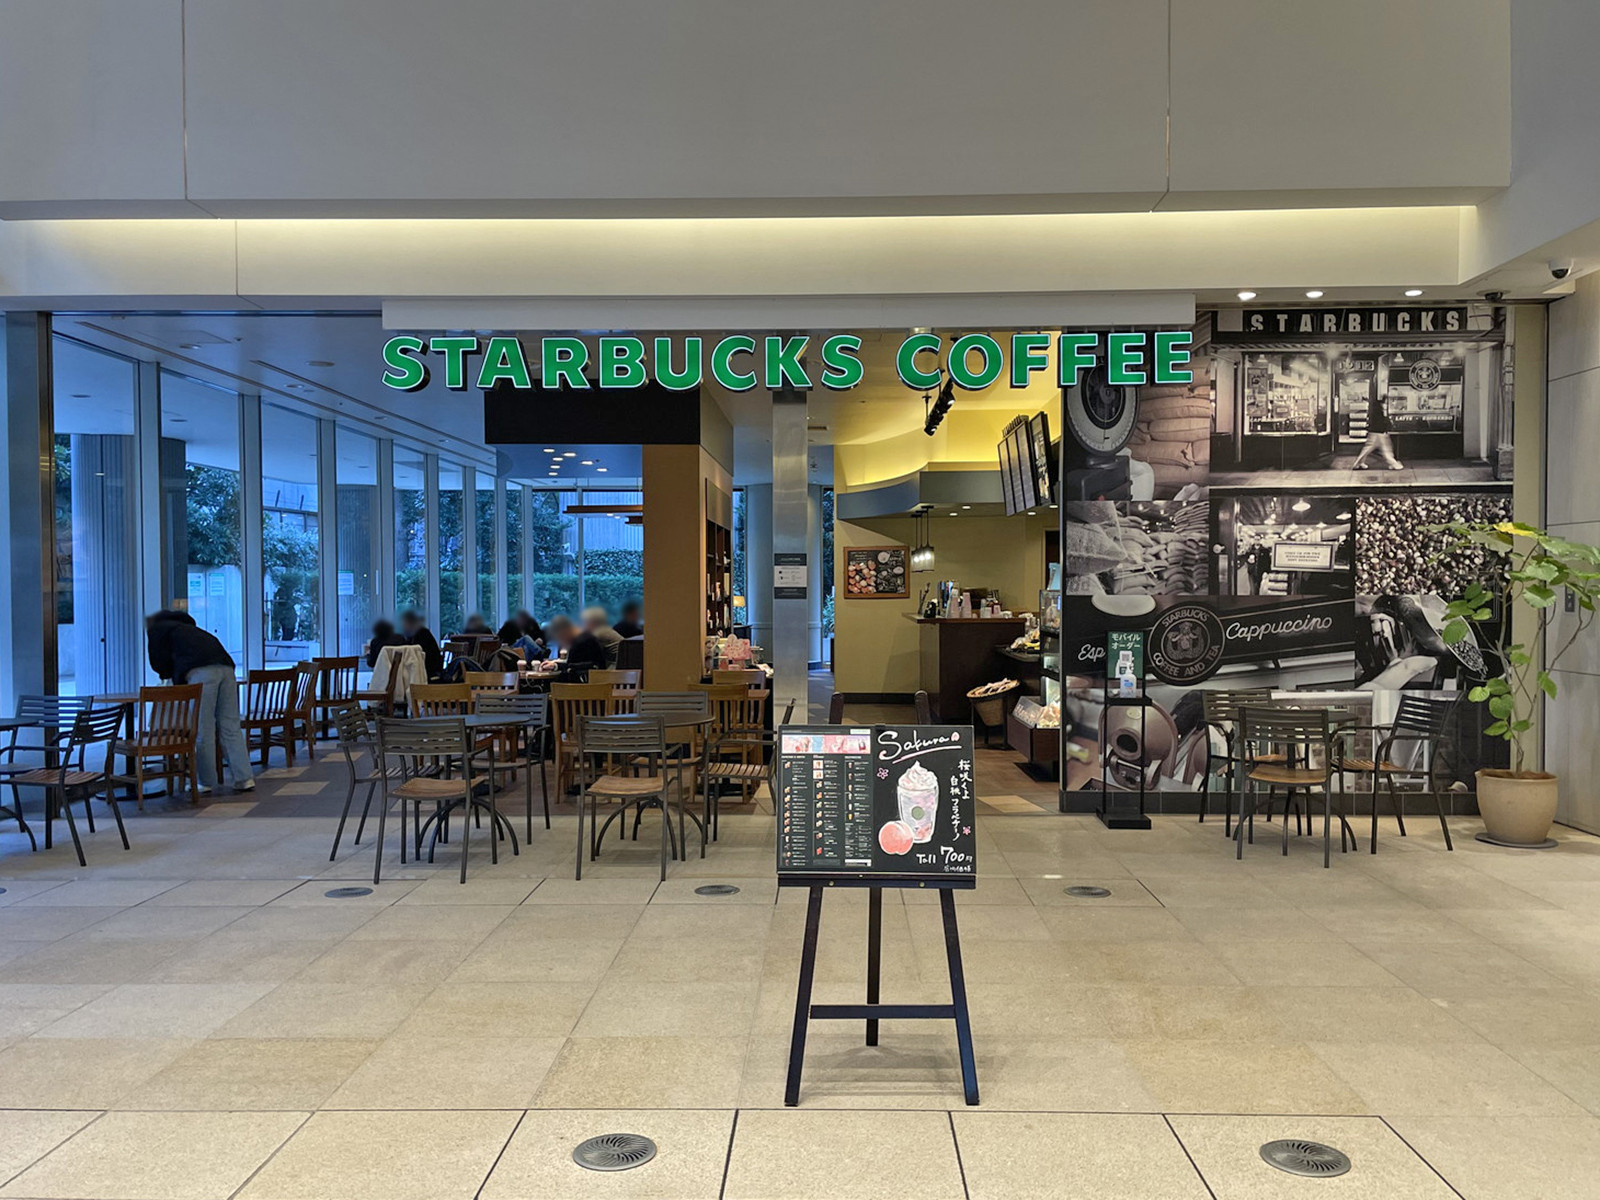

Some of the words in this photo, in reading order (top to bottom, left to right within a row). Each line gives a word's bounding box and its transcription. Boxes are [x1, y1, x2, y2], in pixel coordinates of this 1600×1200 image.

[1250, 311, 1460, 332] STARBUCKS
[381, 334, 865, 391] STARBUCKS
[895, 331, 1194, 390] COFFEE
[1161, 609, 1210, 628] STARBUCKS
[1226, 614, 1332, 641] Cappuccino
[1112, 633, 1141, 641] モバイル
[1112, 642, 1141, 650] オーダー
[1153, 652, 1180, 676] COFFEE
[1184, 662, 1205, 677] AND
[1205, 645, 1221, 661] TEA
[877, 730, 950, 761] Sakura
[916, 853, 936, 864] Tall
